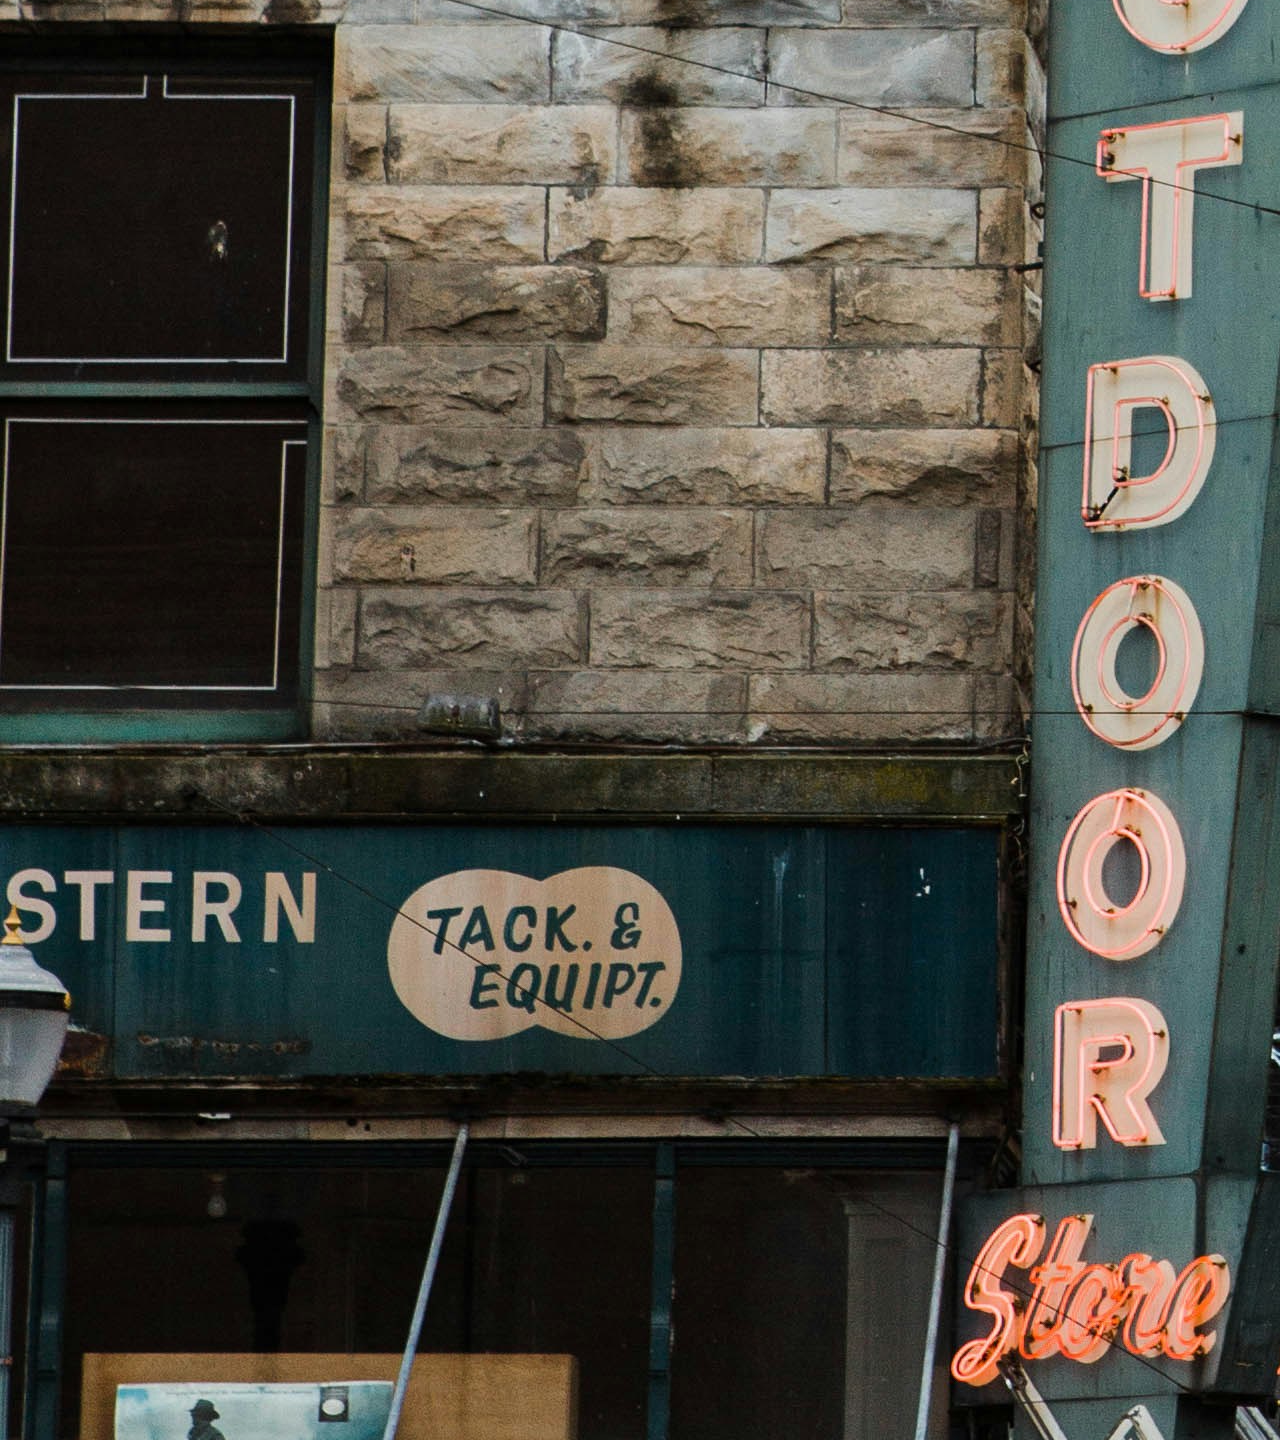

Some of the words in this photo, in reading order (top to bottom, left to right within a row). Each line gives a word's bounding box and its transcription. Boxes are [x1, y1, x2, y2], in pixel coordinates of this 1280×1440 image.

[612, 902, 643, 952] &
[469, 960, 666, 1012] EQUIPT.
[951, 1213, 1231, 1387] Store
